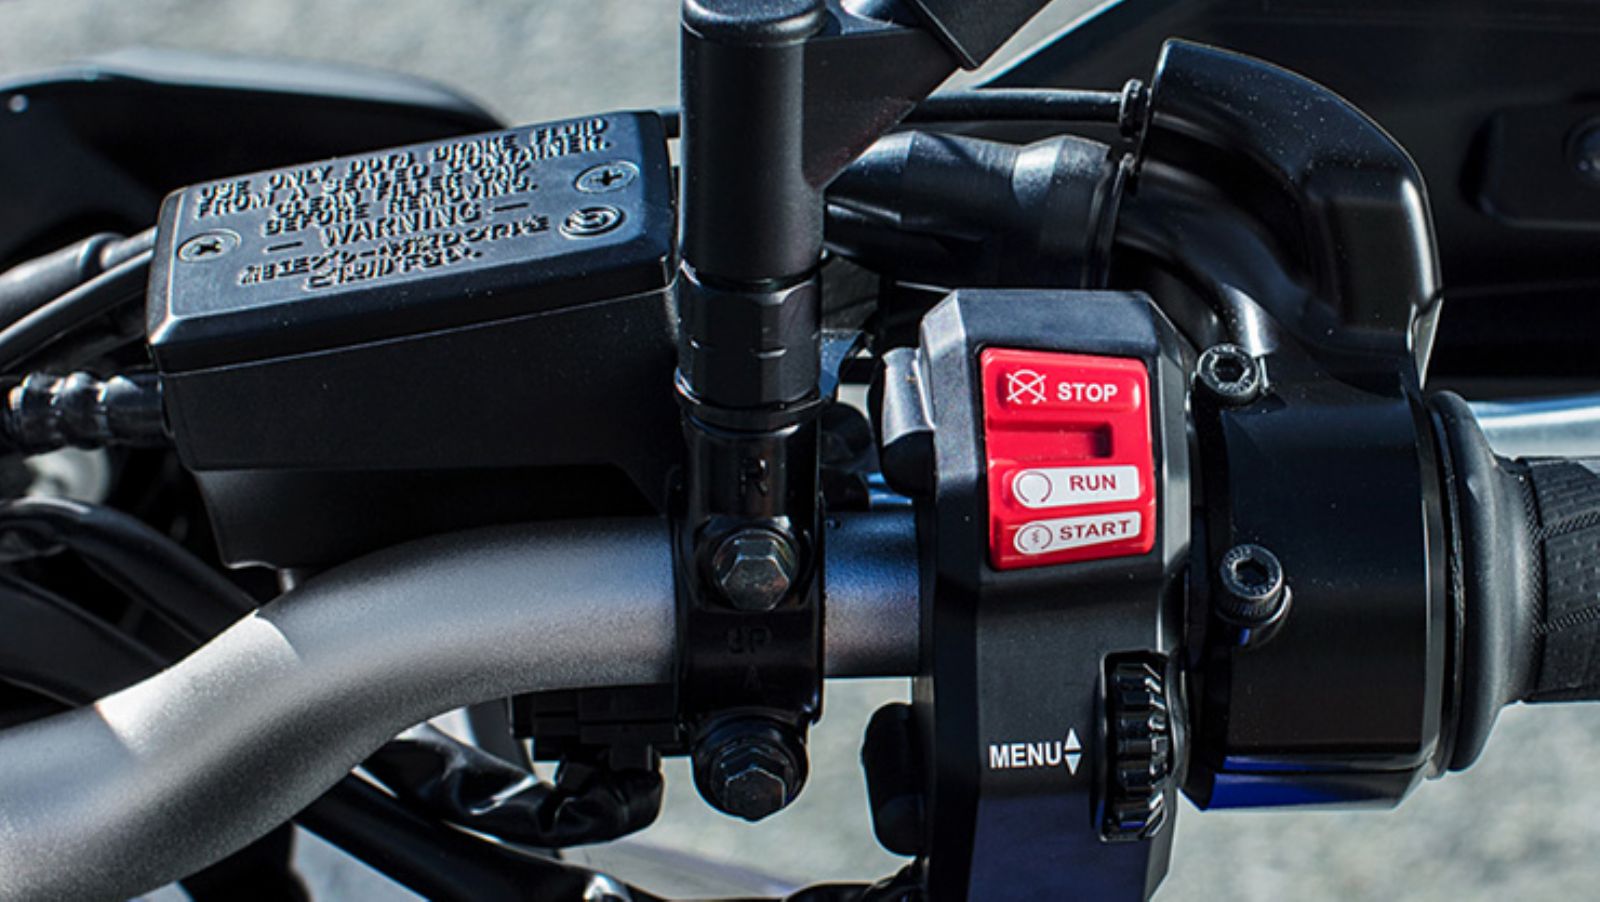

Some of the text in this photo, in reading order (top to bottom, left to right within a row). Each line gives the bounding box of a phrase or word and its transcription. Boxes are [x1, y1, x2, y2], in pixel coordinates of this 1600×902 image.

[266, 165, 334, 191] ONLY
[530, 117, 609, 144] FLUID
[194, 192, 275, 220] FROM
[261, 203, 371, 238] BEFORE
[321, 200, 483, 249] WARNING
[1057, 382, 1118, 402] STOP
[1068, 474, 1117, 491] RUN
[1059, 519, 1131, 541] START
[988, 740, 1063, 769] MENU
